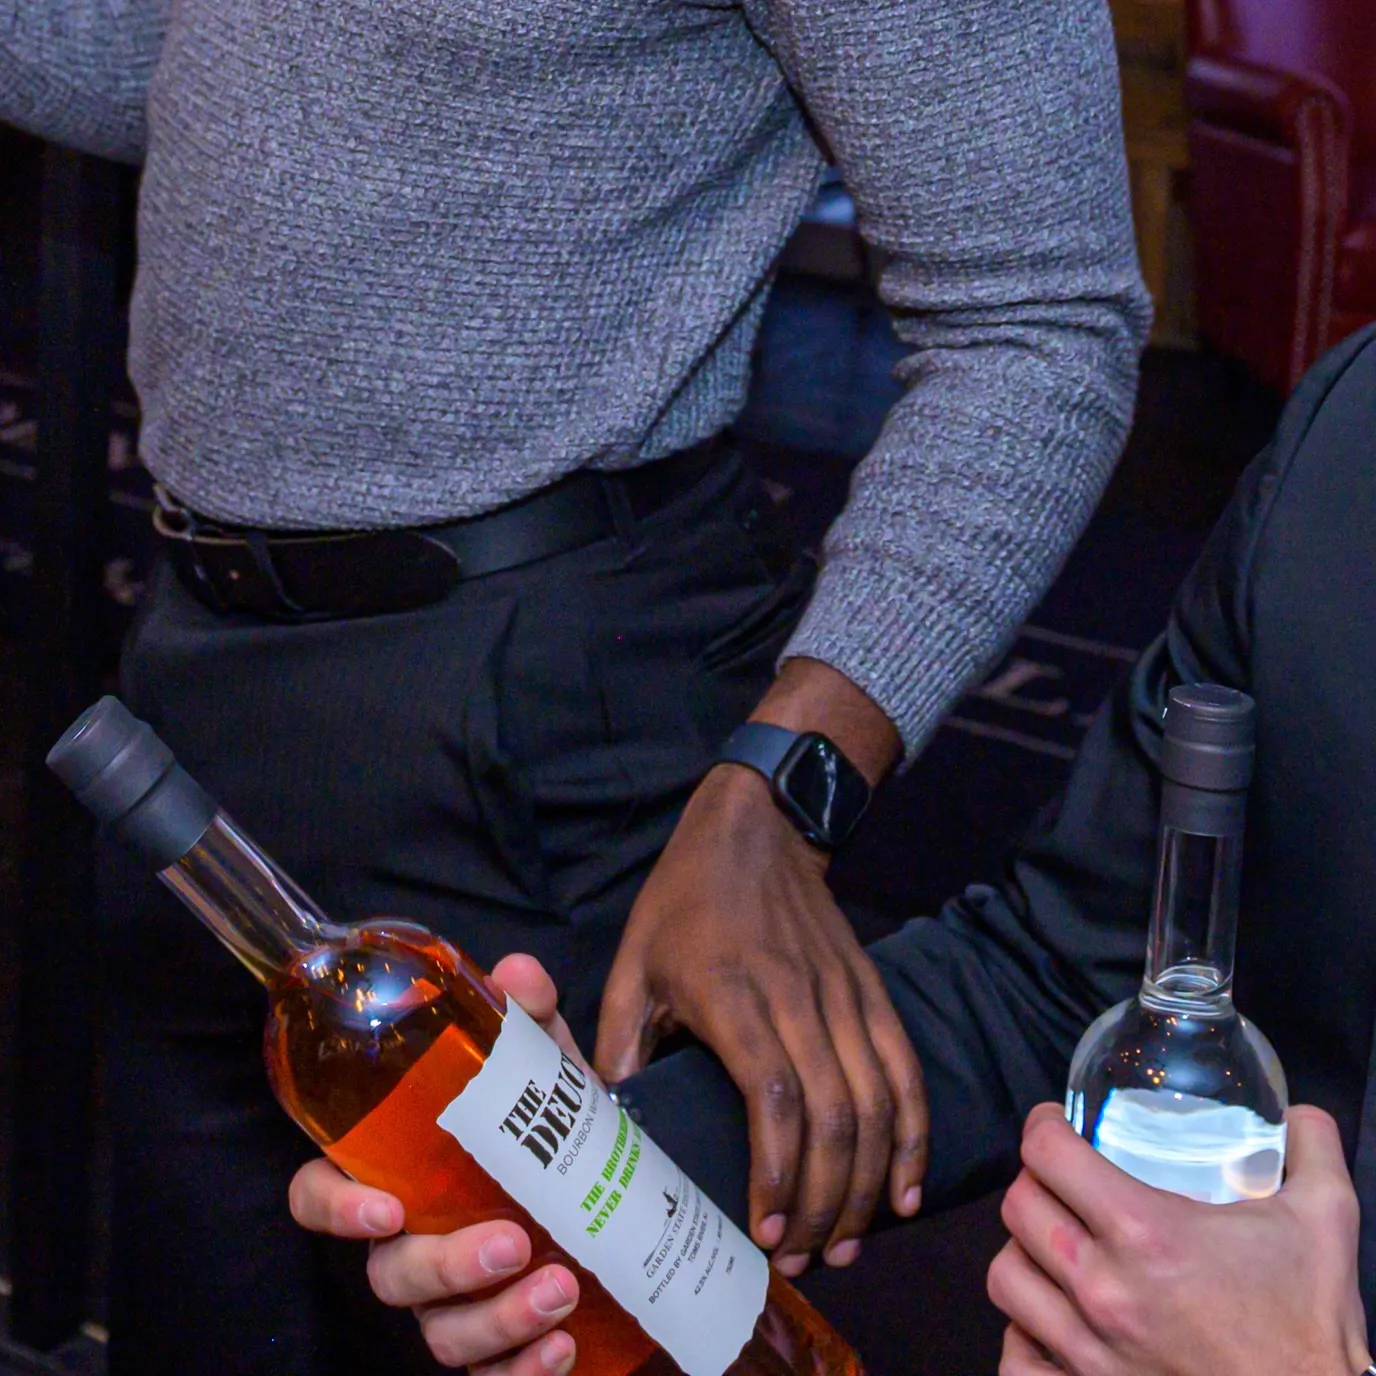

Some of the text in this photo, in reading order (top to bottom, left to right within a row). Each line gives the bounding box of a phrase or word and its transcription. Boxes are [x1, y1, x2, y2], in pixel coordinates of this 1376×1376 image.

[499, 1079, 547, 1141] THE
[557, 1112, 594, 1176] BOURBON
[580, 1180, 605, 1212] THE
[585, 1189, 622, 1239] NEVER
[646, 1234, 675, 1279] GARDEN
[648, 1268, 676, 1304] BOTTLED
[673, 1255, 683, 1269] BY
[680, 1225, 697, 1257] GARDEN
